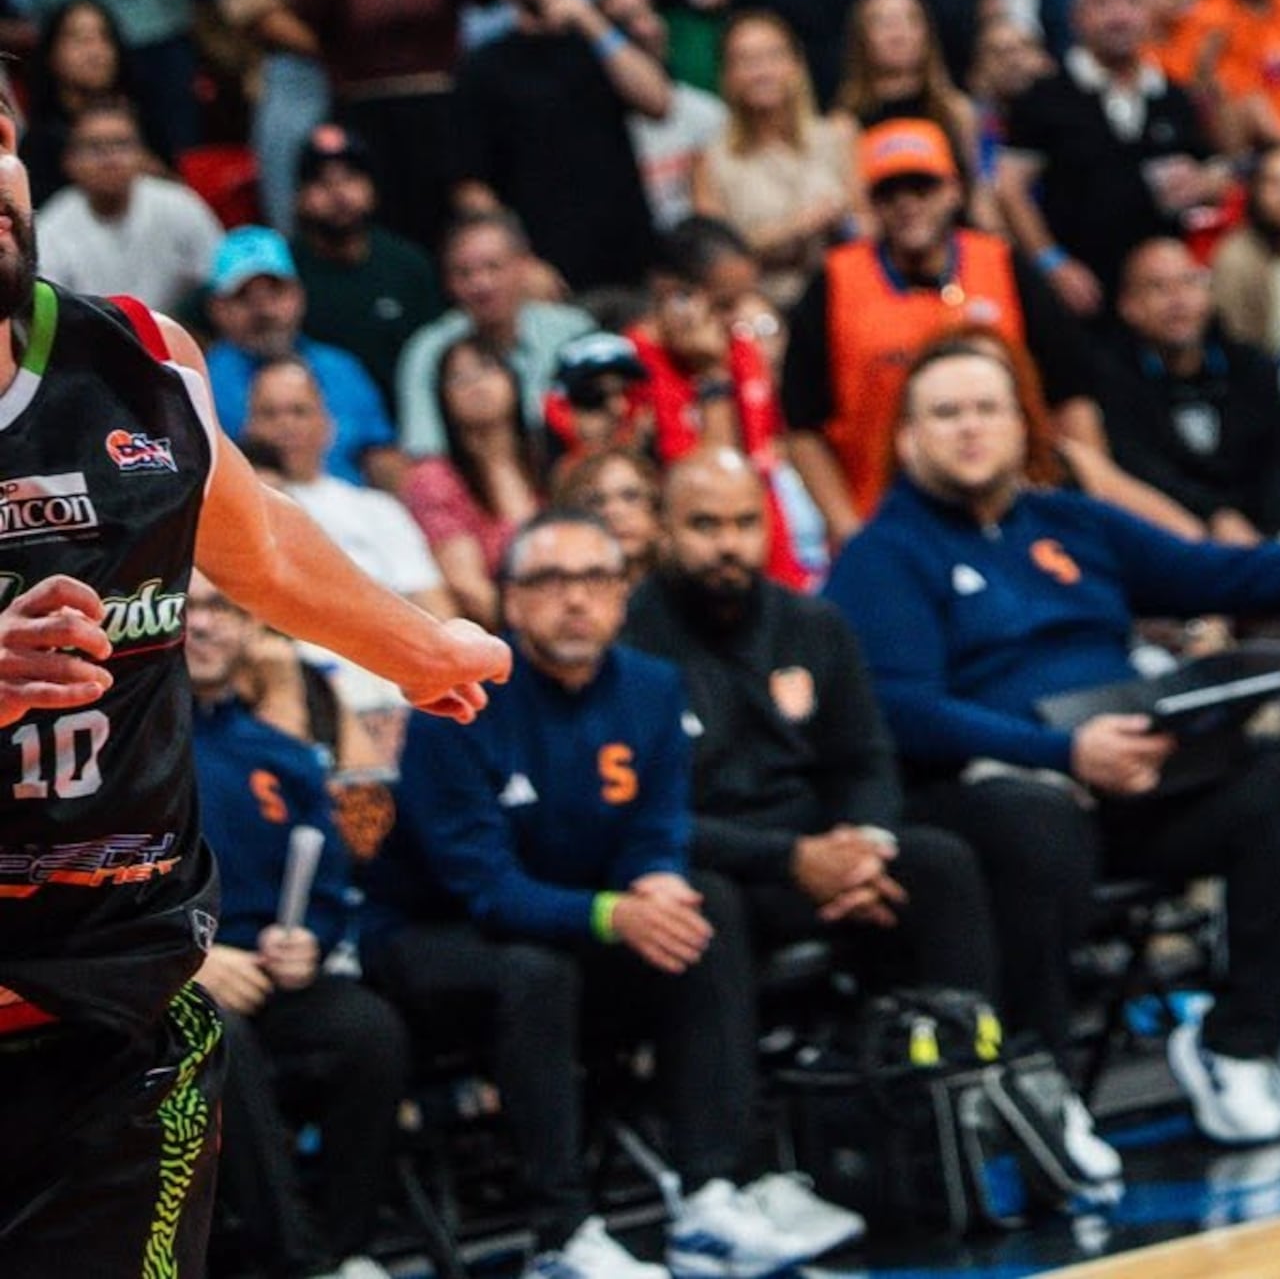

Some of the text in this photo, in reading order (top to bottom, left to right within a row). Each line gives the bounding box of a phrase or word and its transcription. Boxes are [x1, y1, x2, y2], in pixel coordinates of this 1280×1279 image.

[0, 494, 98, 533] ncon
[12, 709, 110, 799] 10
[597, 743, 639, 805] S
[250, 768, 289, 824] S
